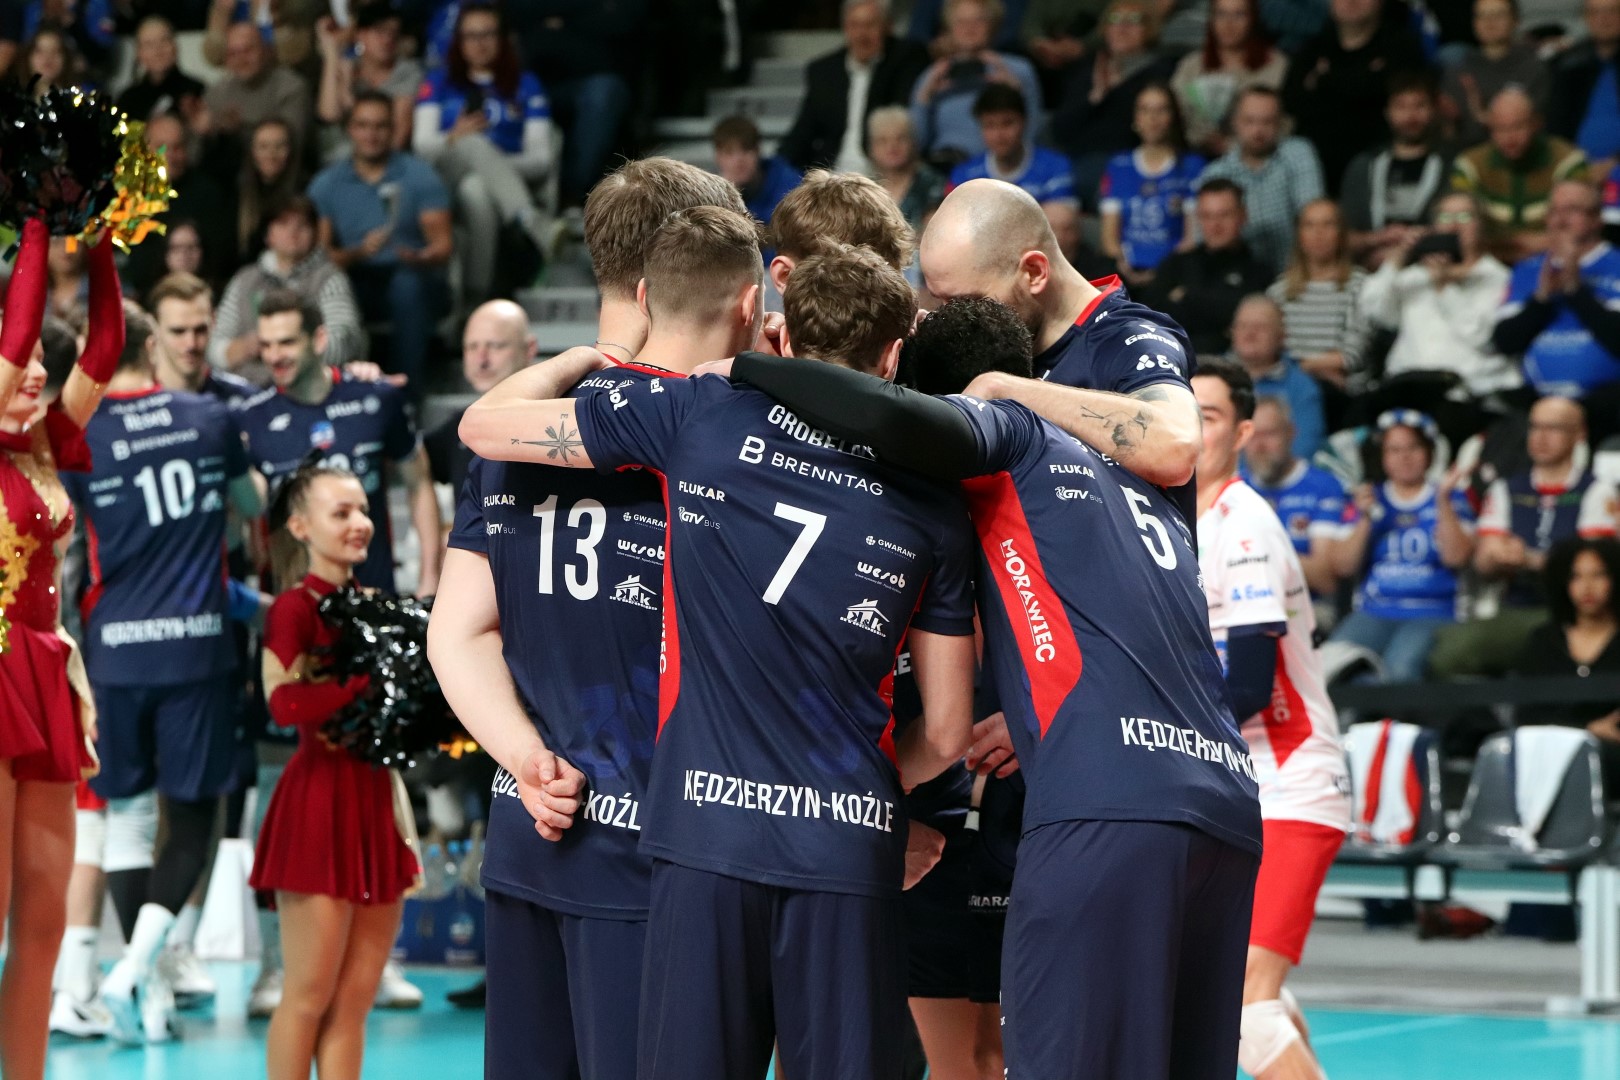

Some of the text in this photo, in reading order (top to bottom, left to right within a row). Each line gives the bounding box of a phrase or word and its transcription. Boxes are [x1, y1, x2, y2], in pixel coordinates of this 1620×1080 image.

[577, 376, 616, 389] plus
[771, 451, 884, 496] BRENNTAG
[1049, 464, 1096, 480] FLUKAR
[133, 458, 196, 527] 10
[483, 494, 516, 508] FLUKAR
[678, 480, 726, 502] FLUKAR
[1062, 489, 1089, 500] GTV
[633, 513, 668, 529] GWARA
[681, 511, 721, 530] GTV BUS
[1119, 484, 1178, 571] 5
[532, 494, 607, 601] 13
[617, 539, 666, 561] wesob
[762, 502, 828, 606] 7
[877, 539, 917, 560] GWARANT
[1386, 527, 1429, 564] 10
[857, 561, 906, 589] wesob
[1000, 538, 1056, 663] MORAWIEC
[683, 769, 894, 833] KĘDZIERZYN-KOŹLE
